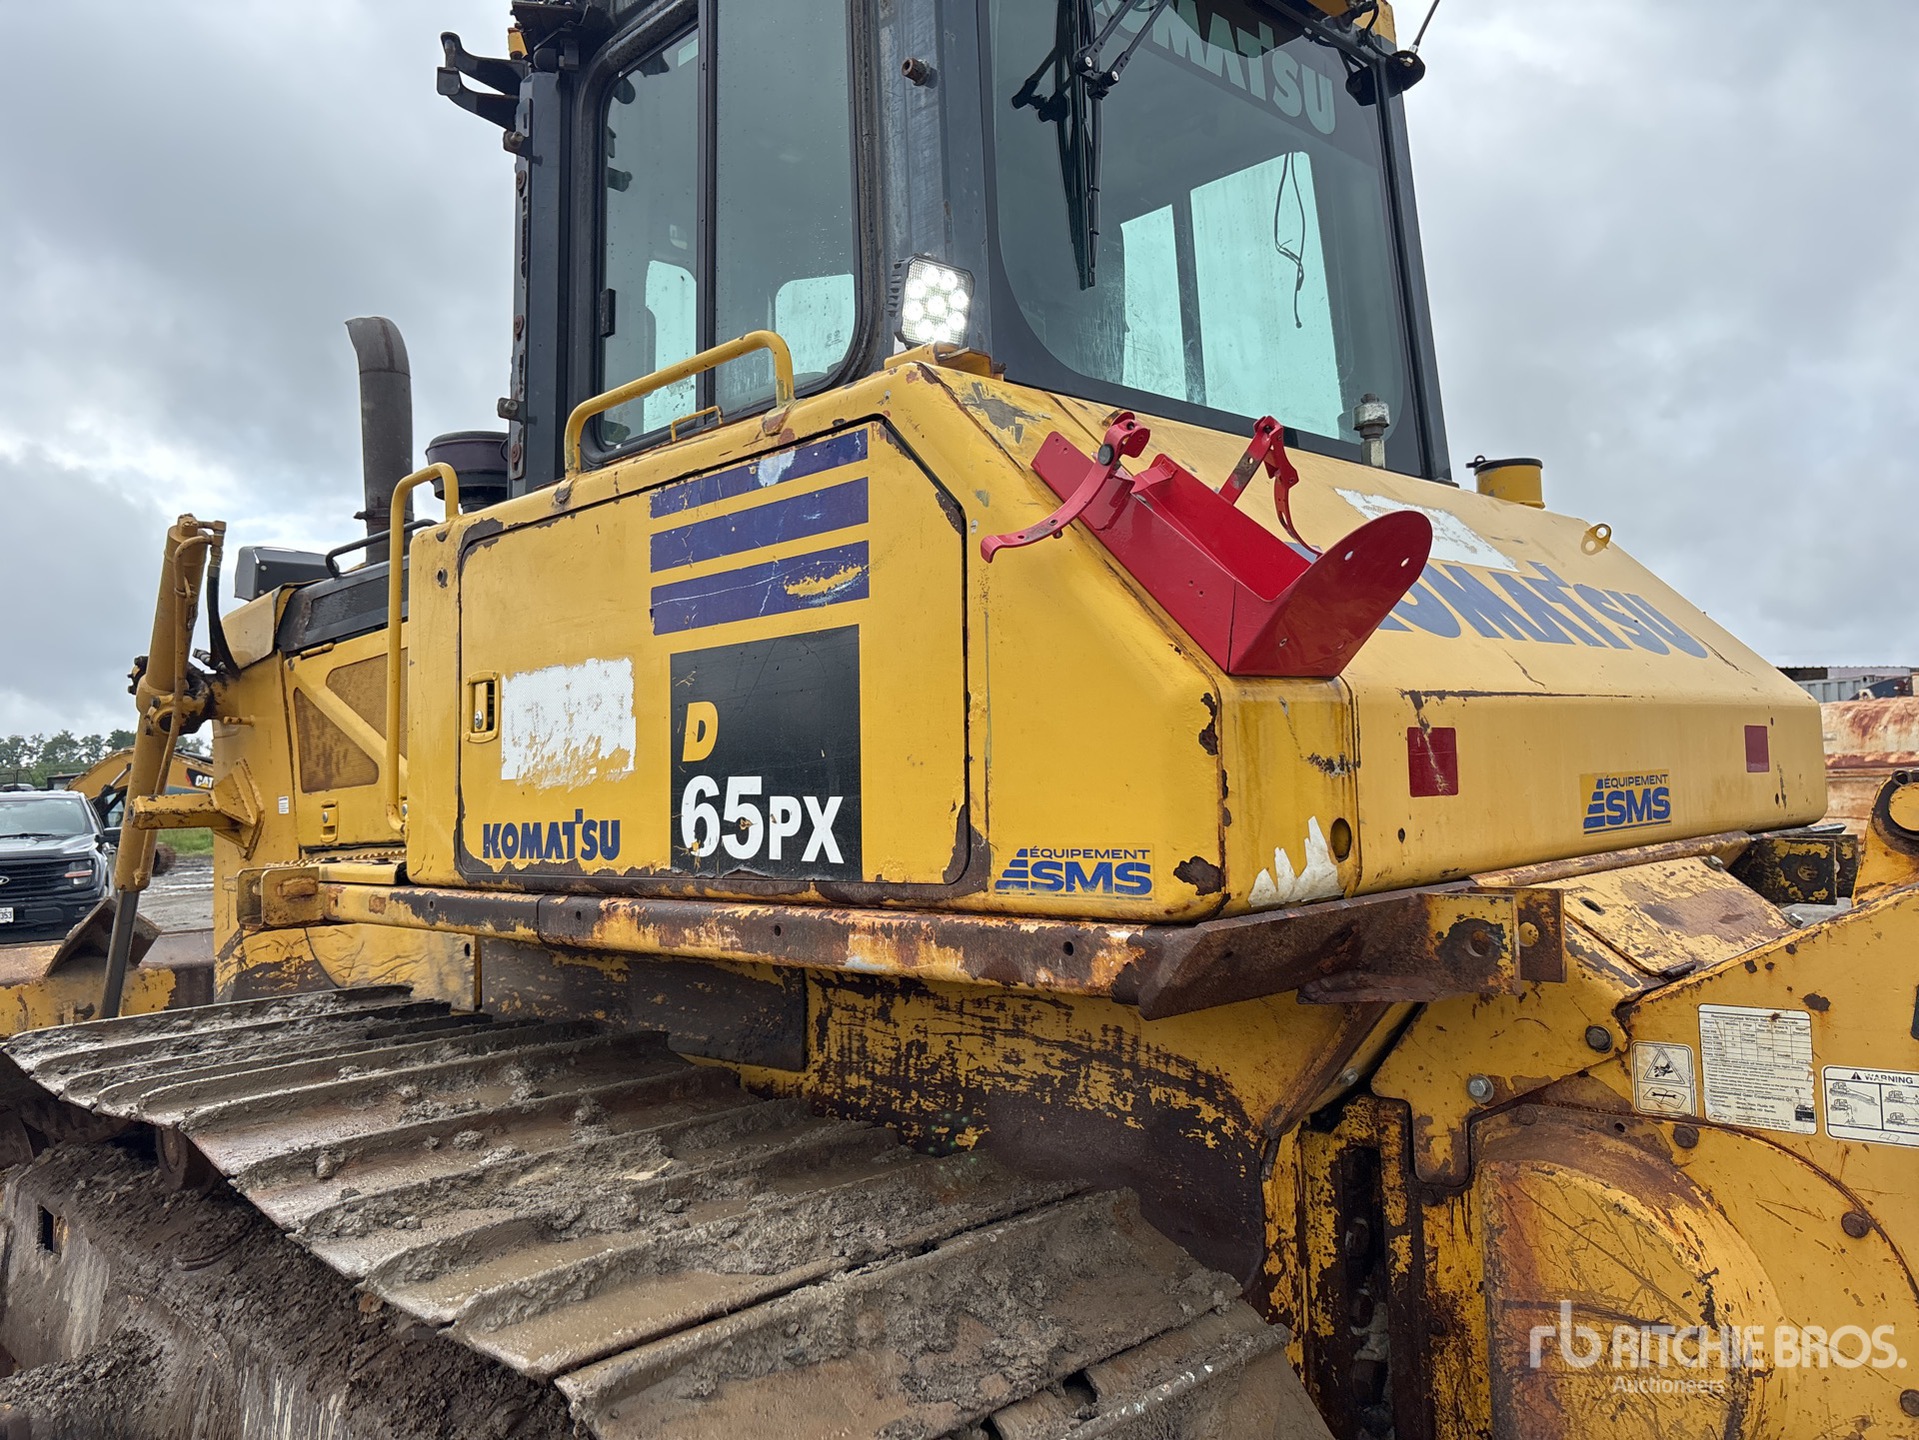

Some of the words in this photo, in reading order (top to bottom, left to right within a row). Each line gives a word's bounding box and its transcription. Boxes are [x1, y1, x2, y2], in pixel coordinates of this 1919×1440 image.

[682, 701, 719, 763] D
[195, 775, 214, 788] CAT
[1604, 774, 1668, 789] ÉQUIPEMENT
[680, 774, 845, 865] 65PX
[1606, 787, 1670, 825] SMS
[482, 808, 621, 861] KOMATSU
[1029, 845, 1150, 860] ÉQUIPEMENT
[1030, 861, 1153, 895] SMS
[1864, 1073, 1914, 1084] WARNING
